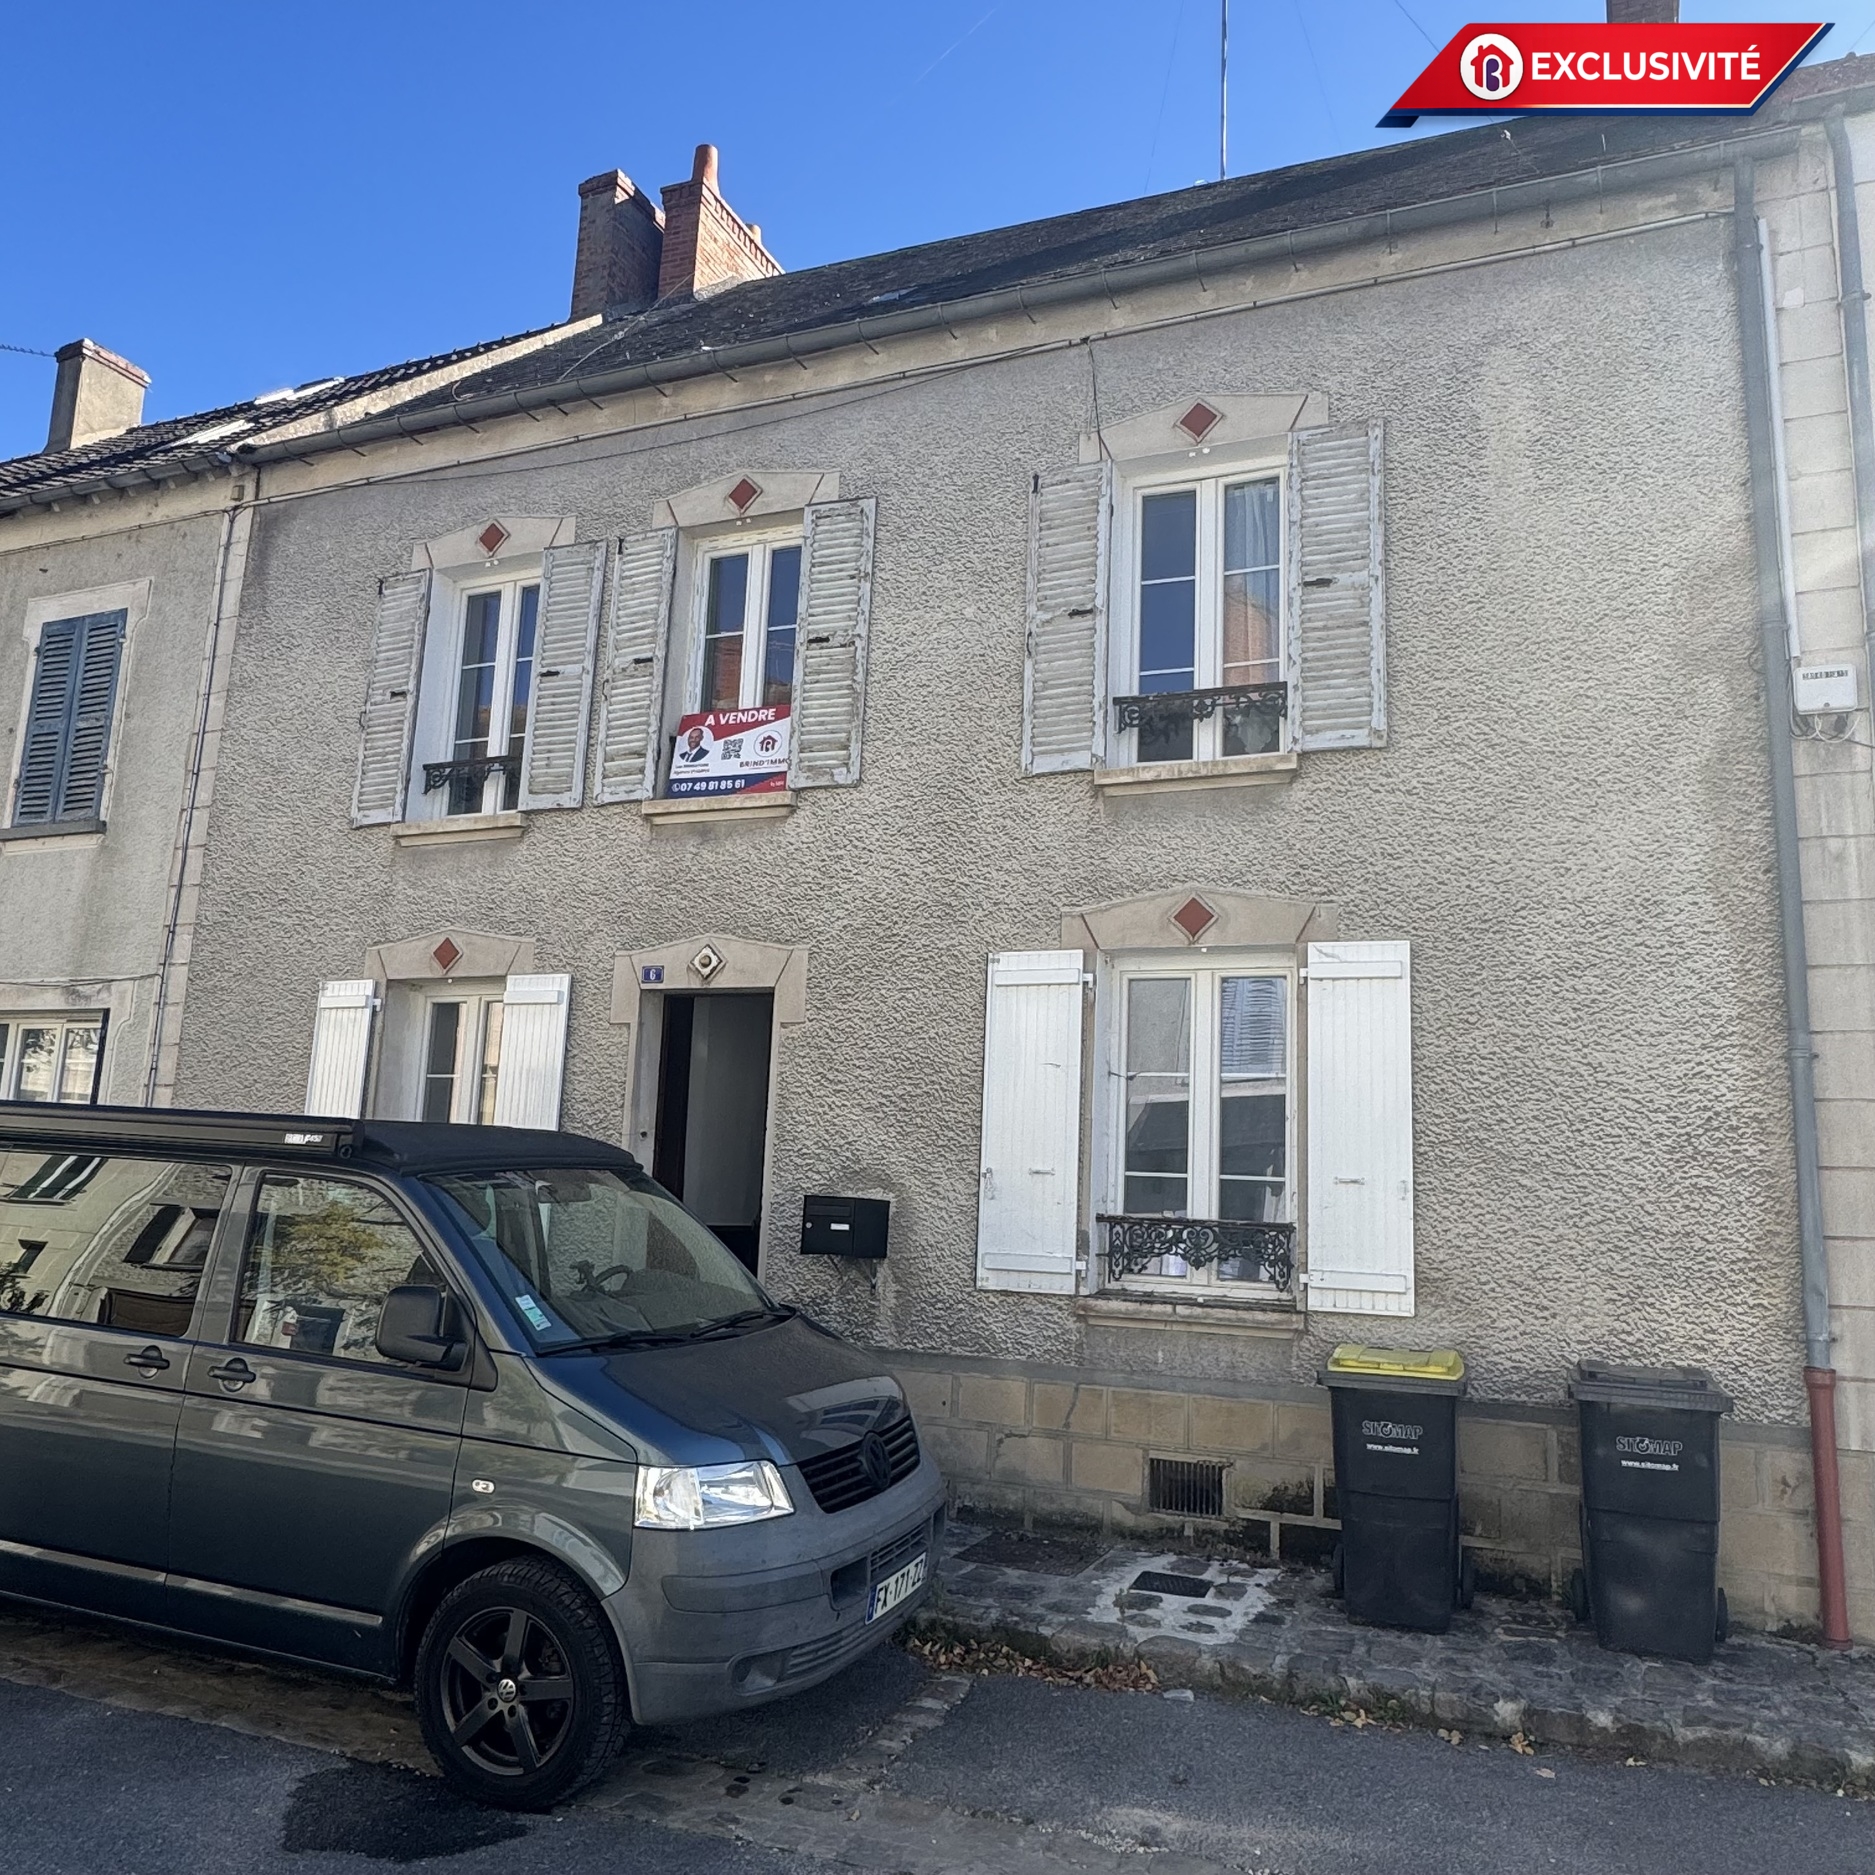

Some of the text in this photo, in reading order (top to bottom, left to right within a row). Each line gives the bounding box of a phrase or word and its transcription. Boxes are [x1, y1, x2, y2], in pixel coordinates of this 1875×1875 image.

[704, 708, 777, 726] A VENDRE
[680, 779, 746, 792] 07 49 81 85 61
[1361, 1420, 1423, 1440] SITOMAP
[1615, 1436, 1683, 1456] SITOMAP
